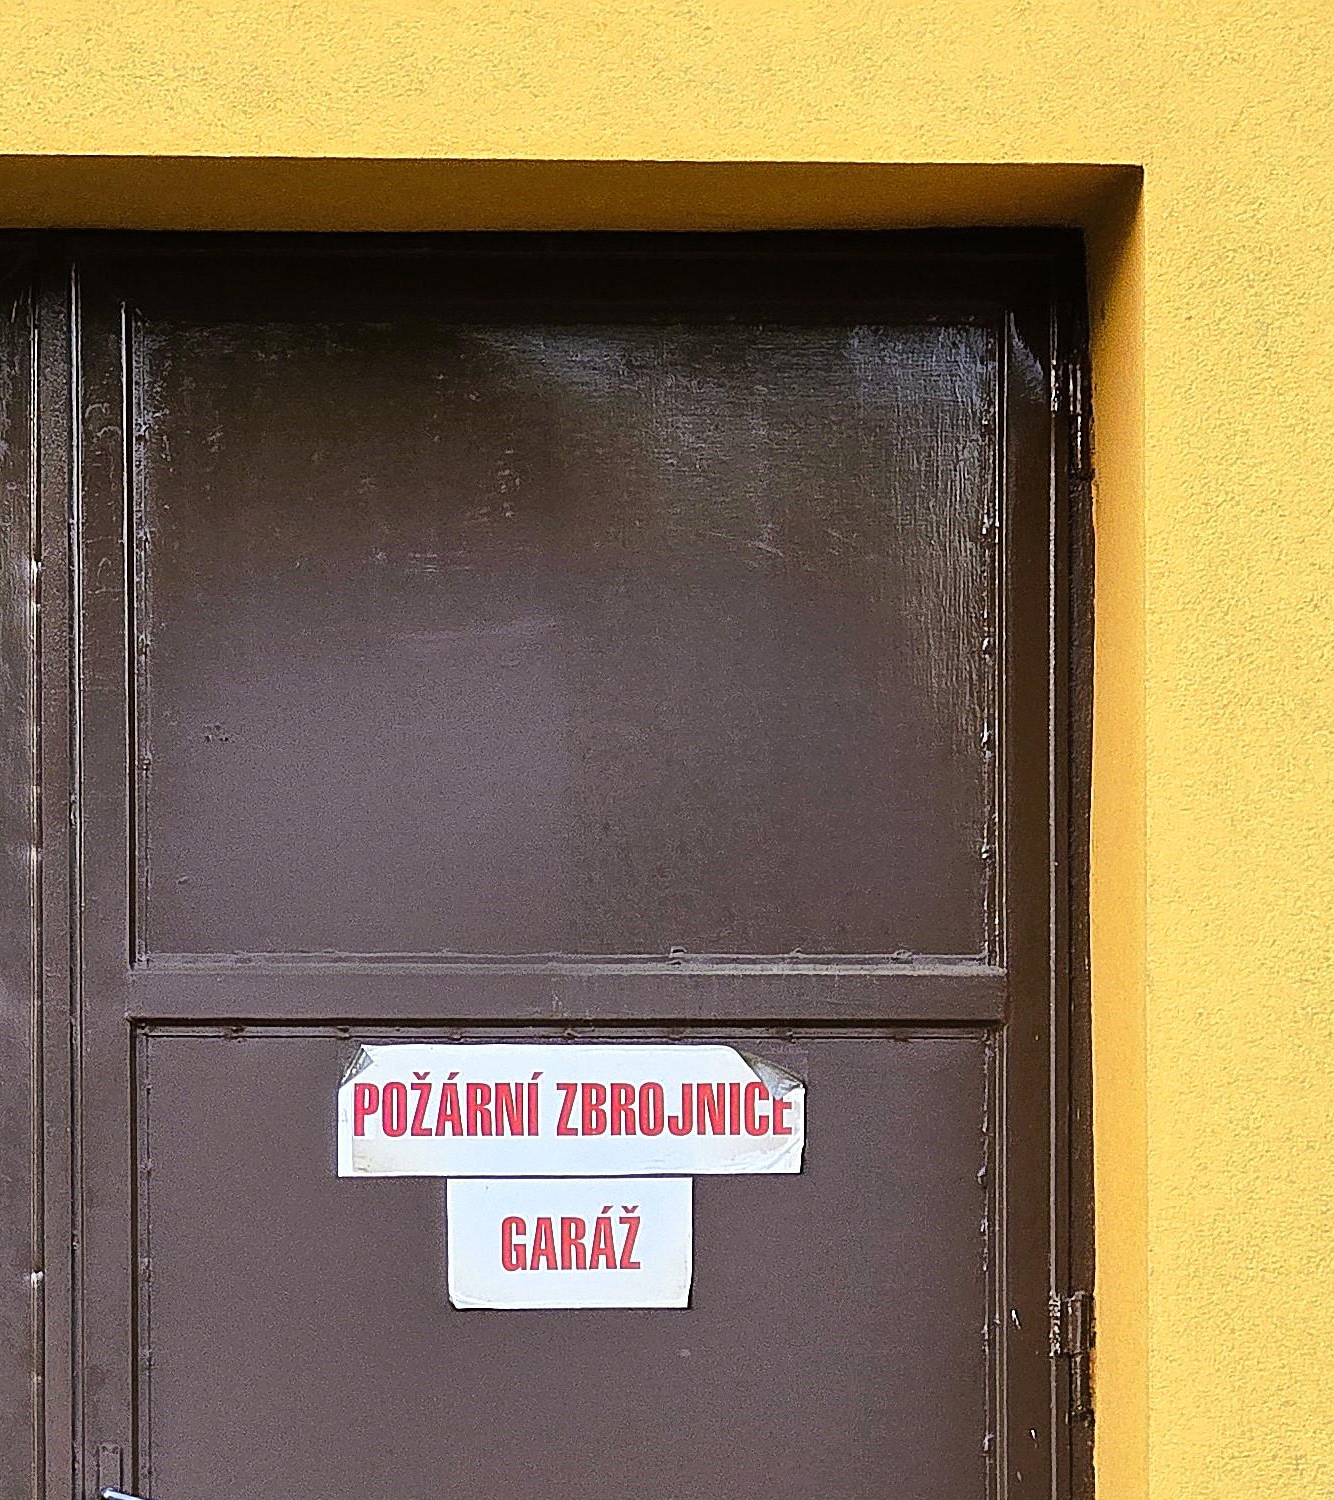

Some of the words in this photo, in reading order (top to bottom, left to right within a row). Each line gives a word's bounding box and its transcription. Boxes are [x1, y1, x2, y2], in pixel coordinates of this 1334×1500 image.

[353, 1071, 544, 1137] POŽÁRNÍ
[556, 1081, 793, 1136] ZBROJNICE
[501, 1205, 641, 1272] GARÁŽ
